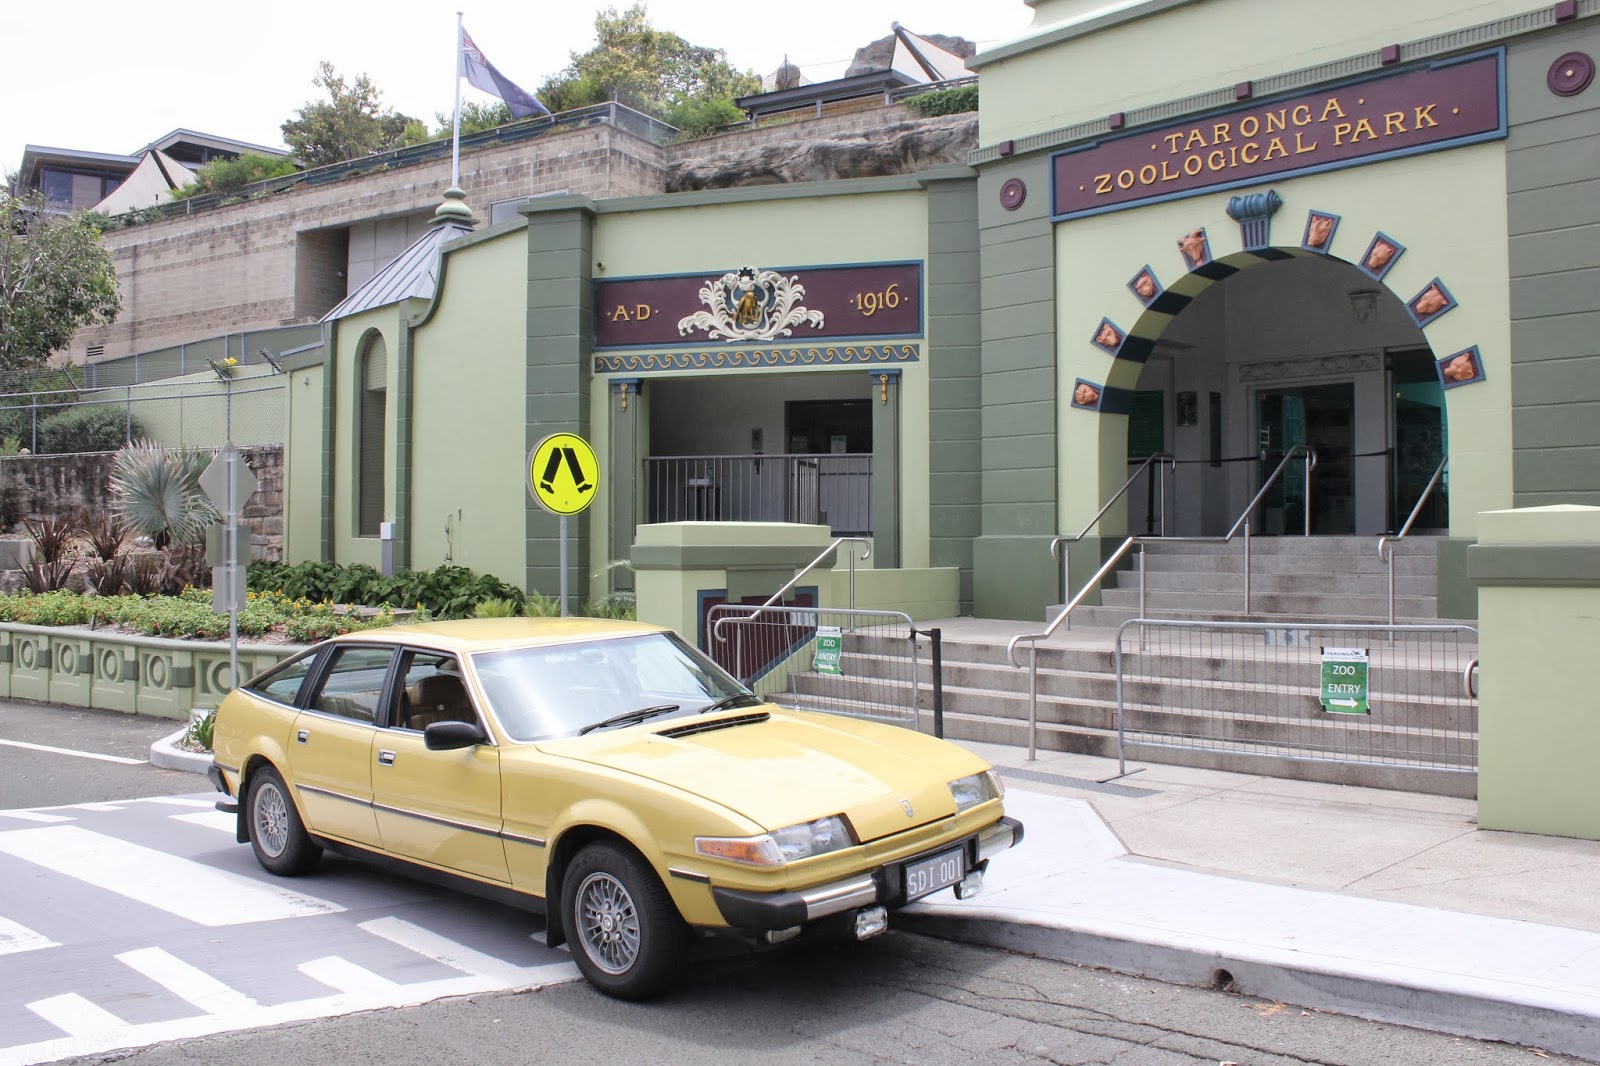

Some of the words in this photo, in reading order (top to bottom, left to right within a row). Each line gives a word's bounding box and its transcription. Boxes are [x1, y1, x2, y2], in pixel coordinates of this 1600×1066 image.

[1164, 98, 1346, 154] TARONGA
[1093, 132, 1318, 195] ZOOLOGICAL
[1333, 103, 1439, 146] PARK
[856, 283, 900, 317] 1916
[823, 639, 835, 647] ZOO
[1332, 666, 1355, 676] ZOO
[1328, 683, 1361, 694] ENTRY
